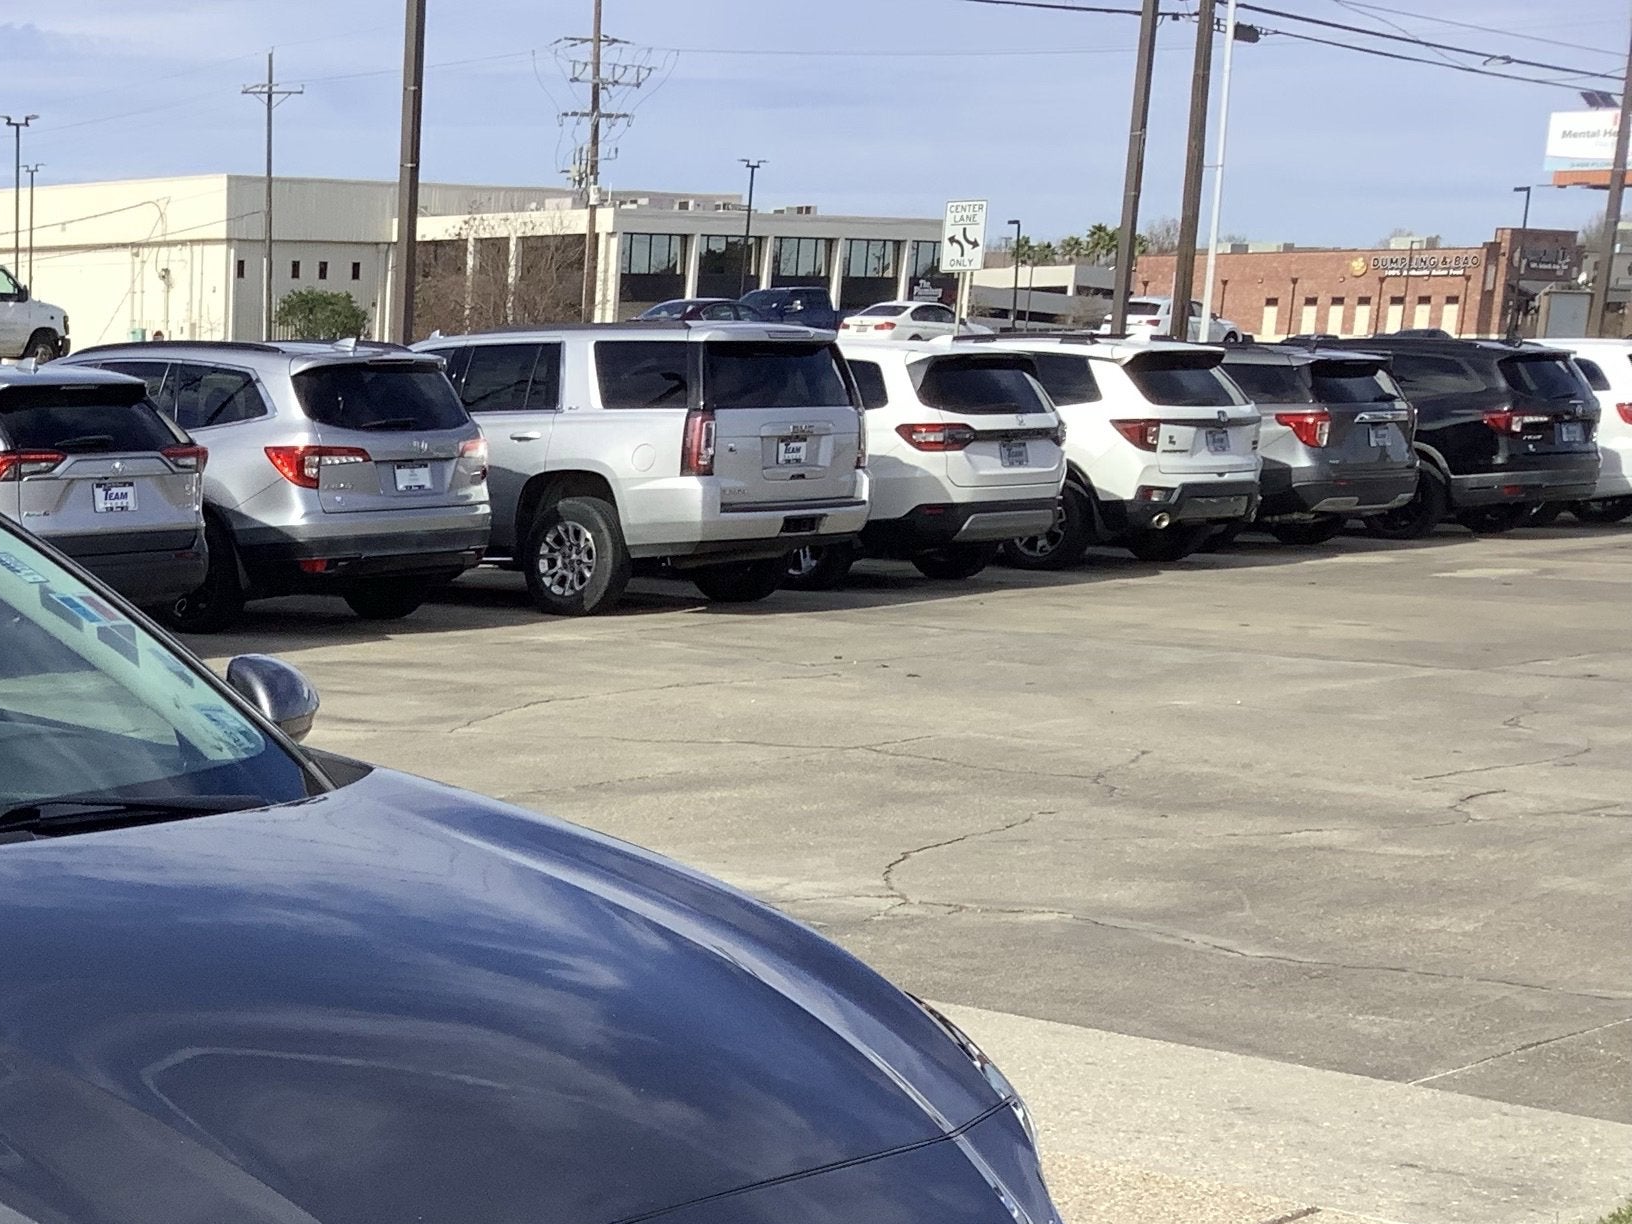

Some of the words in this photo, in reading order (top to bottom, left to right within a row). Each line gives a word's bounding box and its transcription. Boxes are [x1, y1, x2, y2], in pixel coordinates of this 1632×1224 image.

[1561, 129, 1601, 139] Mental
[949, 204, 984, 214] CENTER
[953, 214, 978, 223] LANE
[949, 258, 974, 268] ONLY
[1440, 255, 1450, 268] &
[1452, 254, 1481, 269] BAO
[102, 486, 129, 501] TEAM
